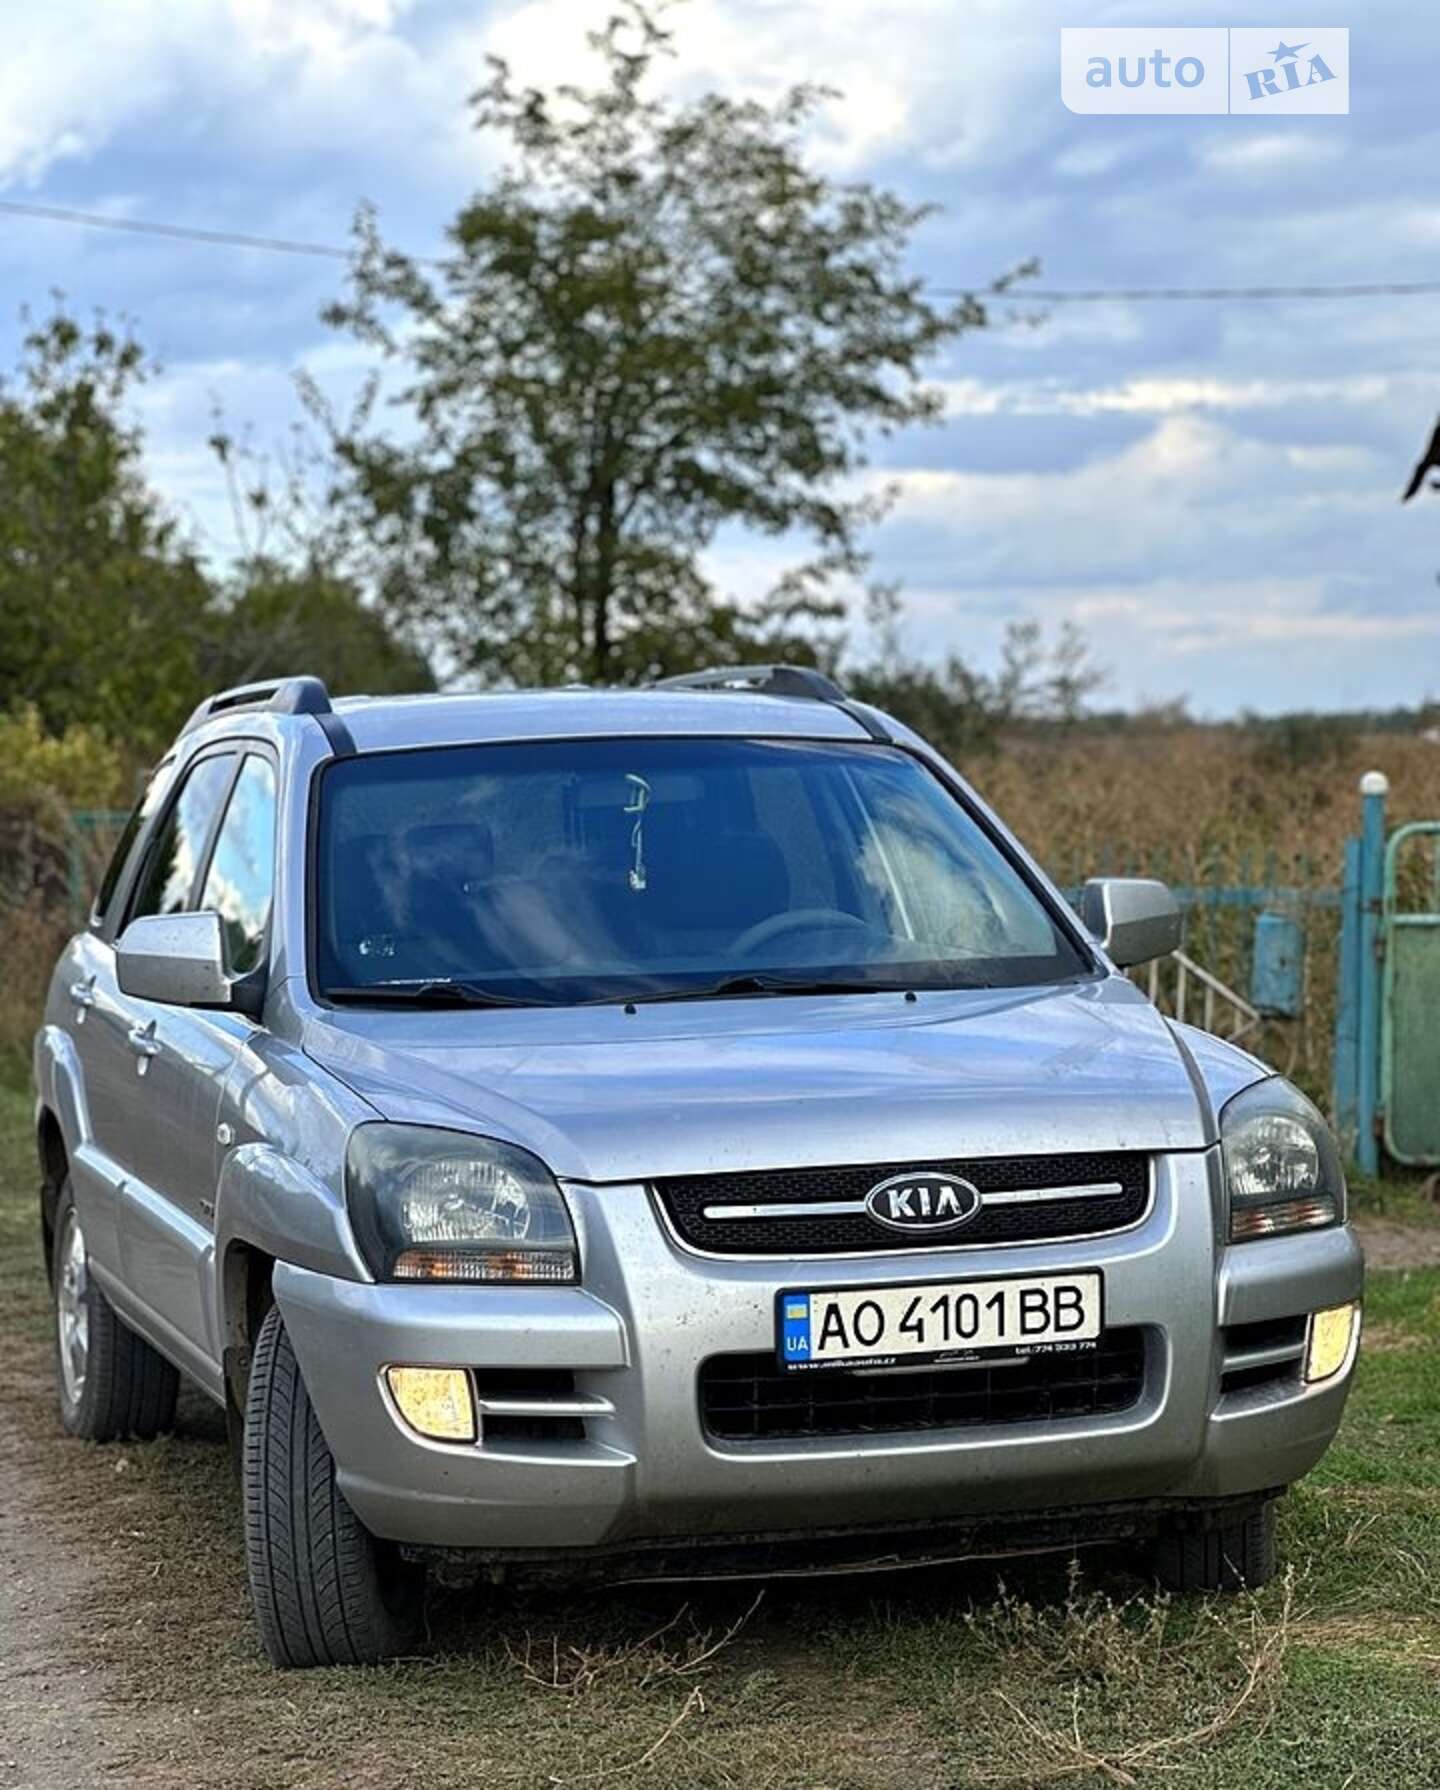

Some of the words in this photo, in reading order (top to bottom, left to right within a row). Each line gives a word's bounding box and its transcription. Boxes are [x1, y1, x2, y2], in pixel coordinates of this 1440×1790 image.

[886, 1185, 962, 1219] KIA
[817, 1299, 885, 1351] AO
[899, 1290, 1006, 1343] 4101
[1019, 1285, 1086, 1335] BB
[786, 1335, 809, 1352] UA
